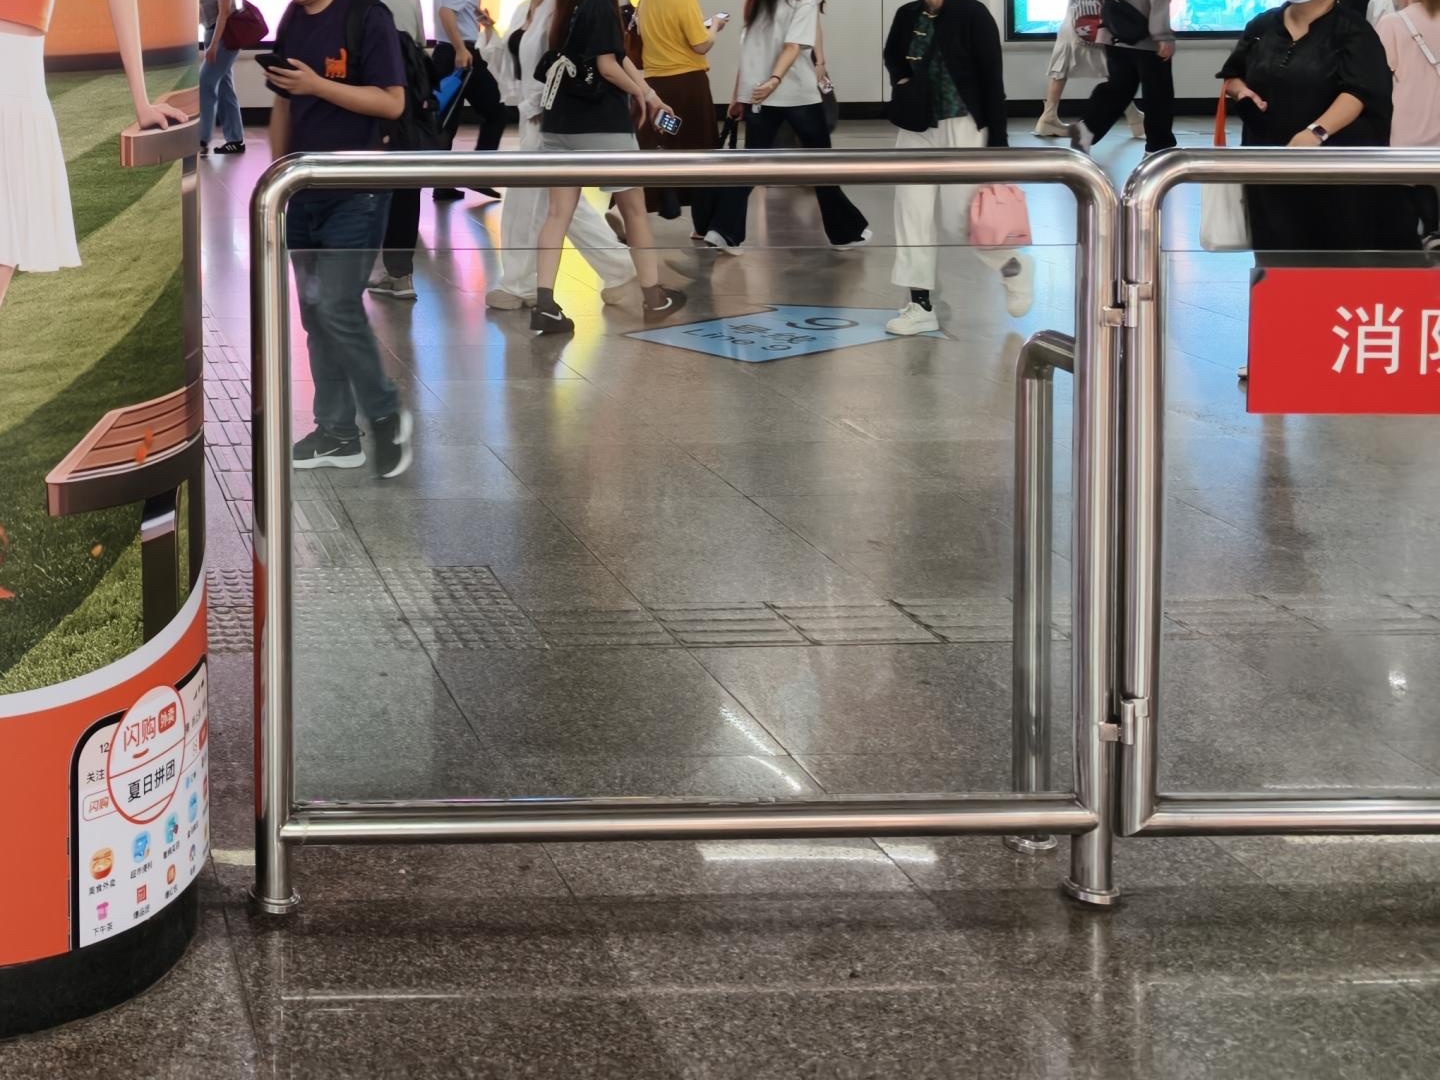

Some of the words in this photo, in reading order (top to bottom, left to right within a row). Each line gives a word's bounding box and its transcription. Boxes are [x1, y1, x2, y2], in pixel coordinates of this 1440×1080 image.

[682, 328, 756, 346] Line
[1332, 303, 1440, 375] 消
[123, 716, 157, 752] 闪购
[128, 759, 176, 803] 夏日拼团
